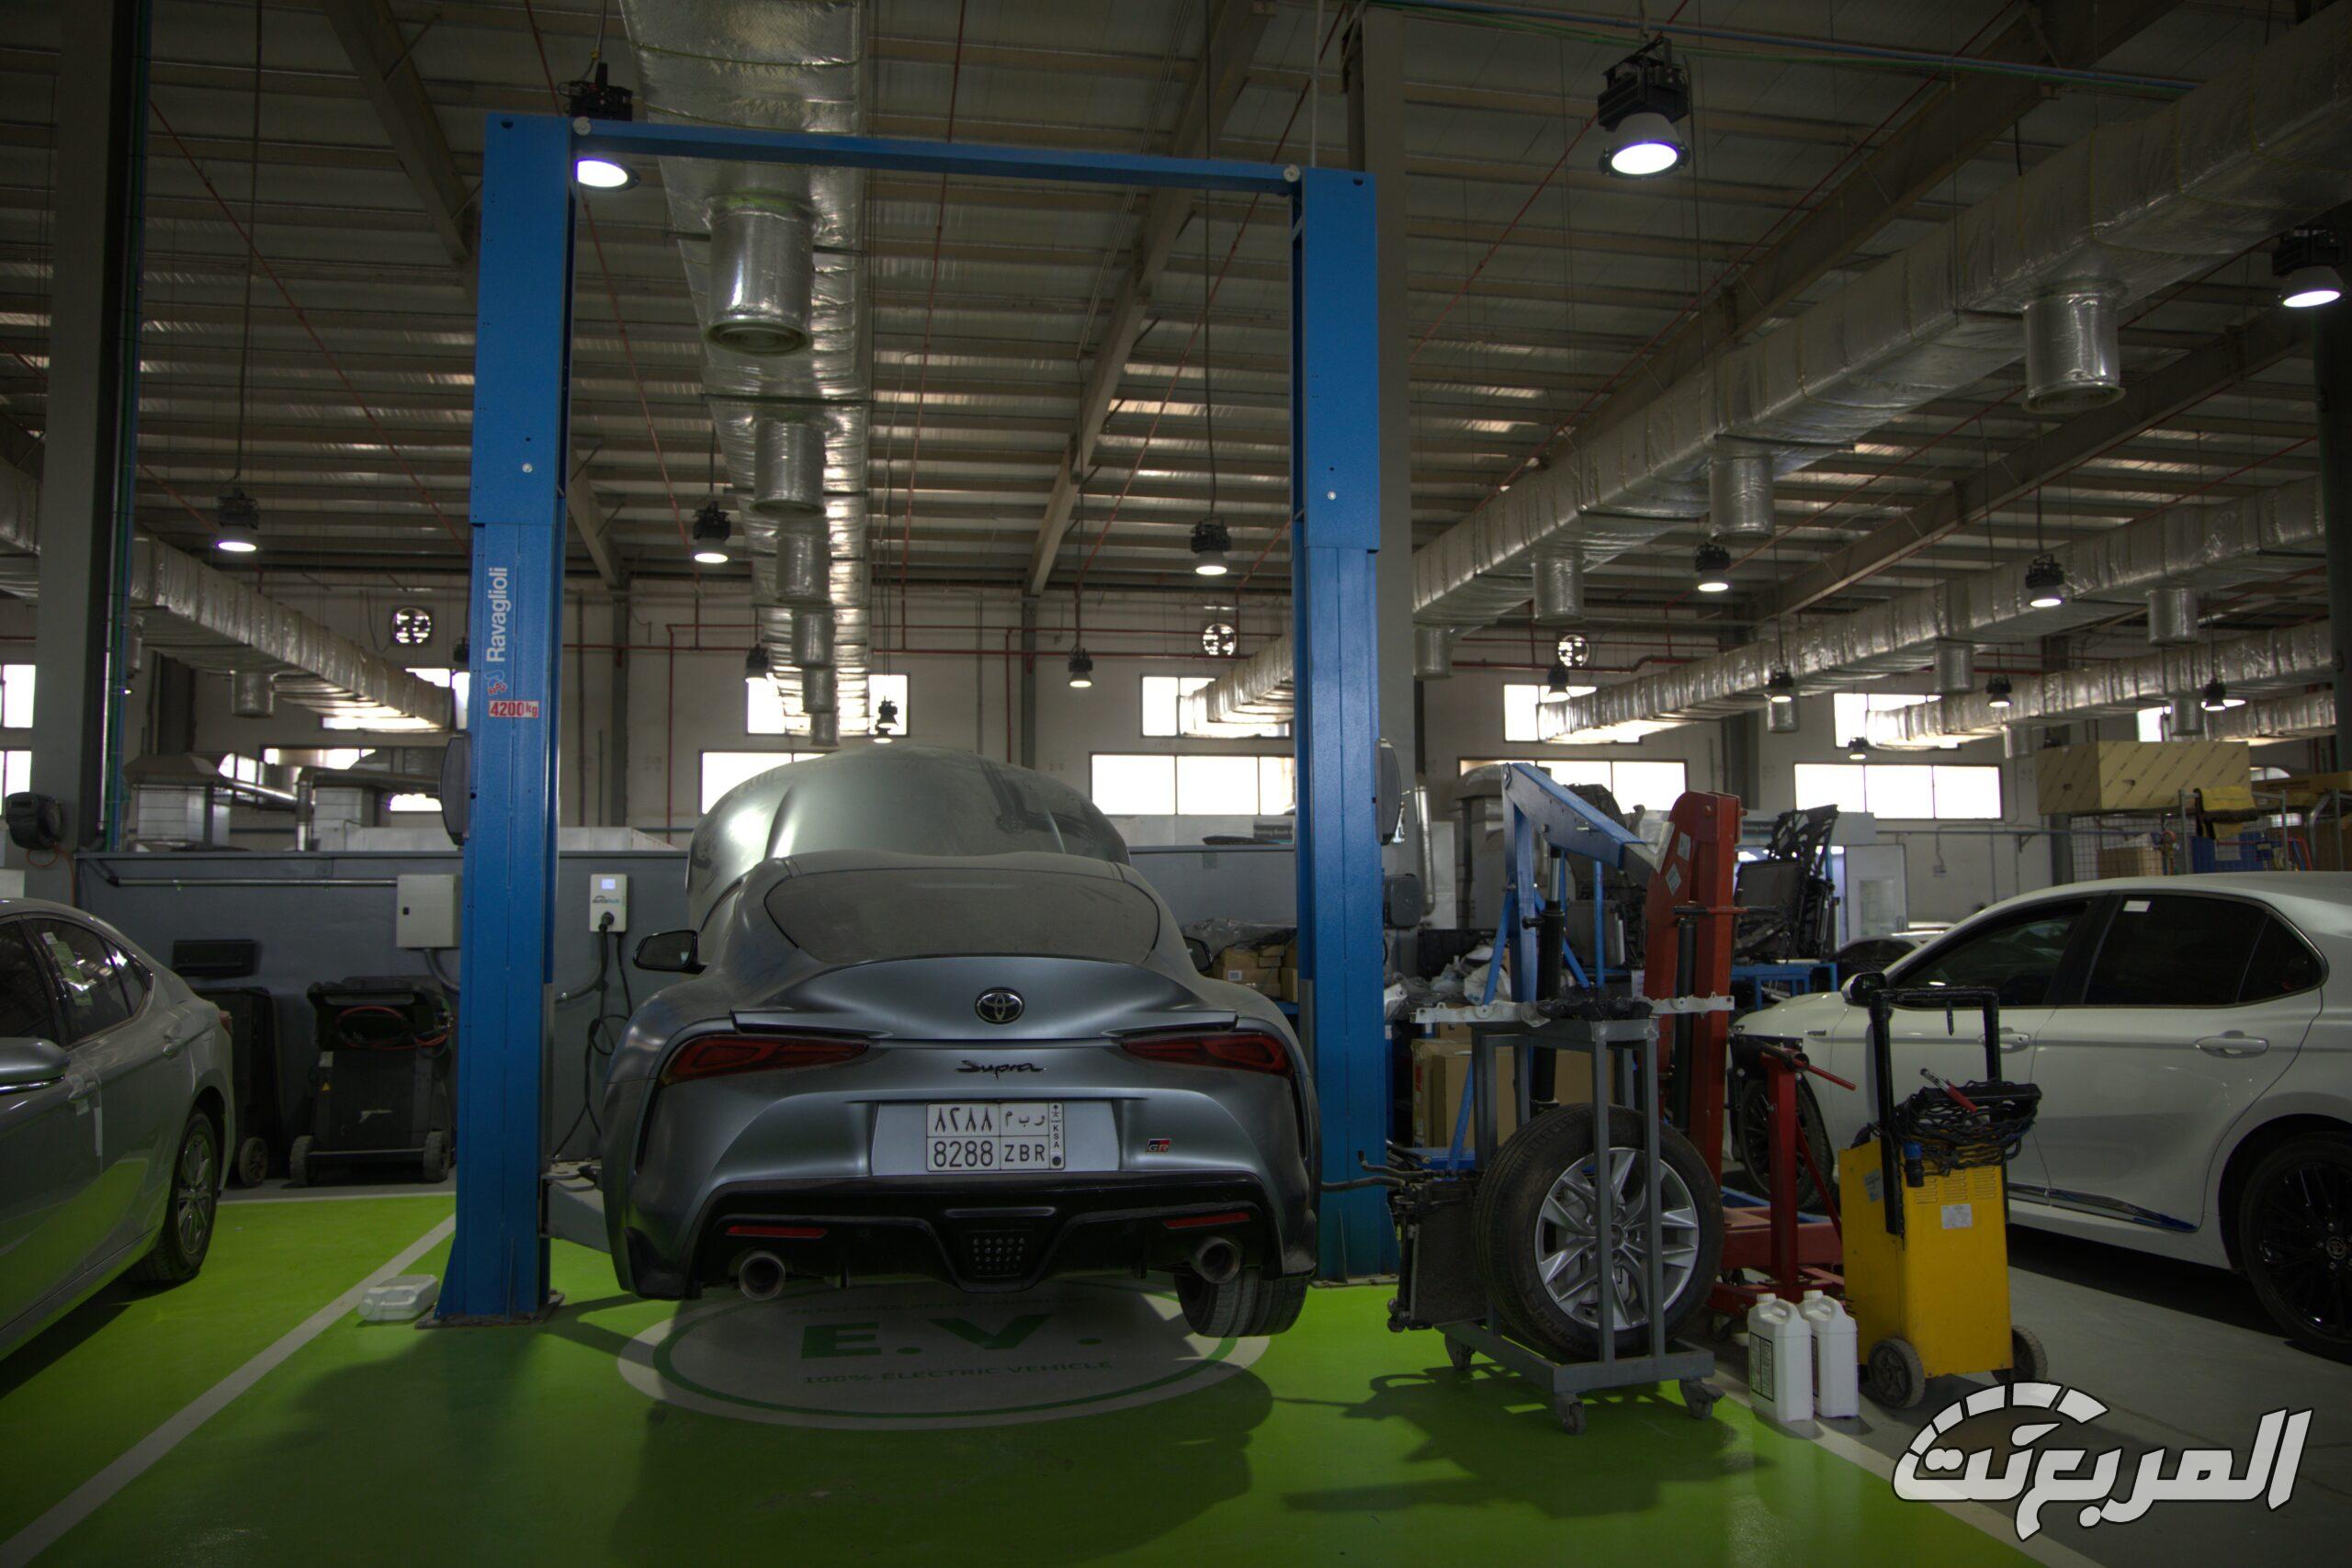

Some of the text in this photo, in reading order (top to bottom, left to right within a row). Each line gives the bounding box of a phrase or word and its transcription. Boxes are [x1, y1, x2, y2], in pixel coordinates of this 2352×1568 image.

[486, 567, 512, 662] Ravaglioli
[956, 1059, 1046, 1080] Supra
[933, 1140, 1046, 1168] 8288 ZBR
[806, 1360, 1113, 1383] 100% ELECTRIC VEHICLE
